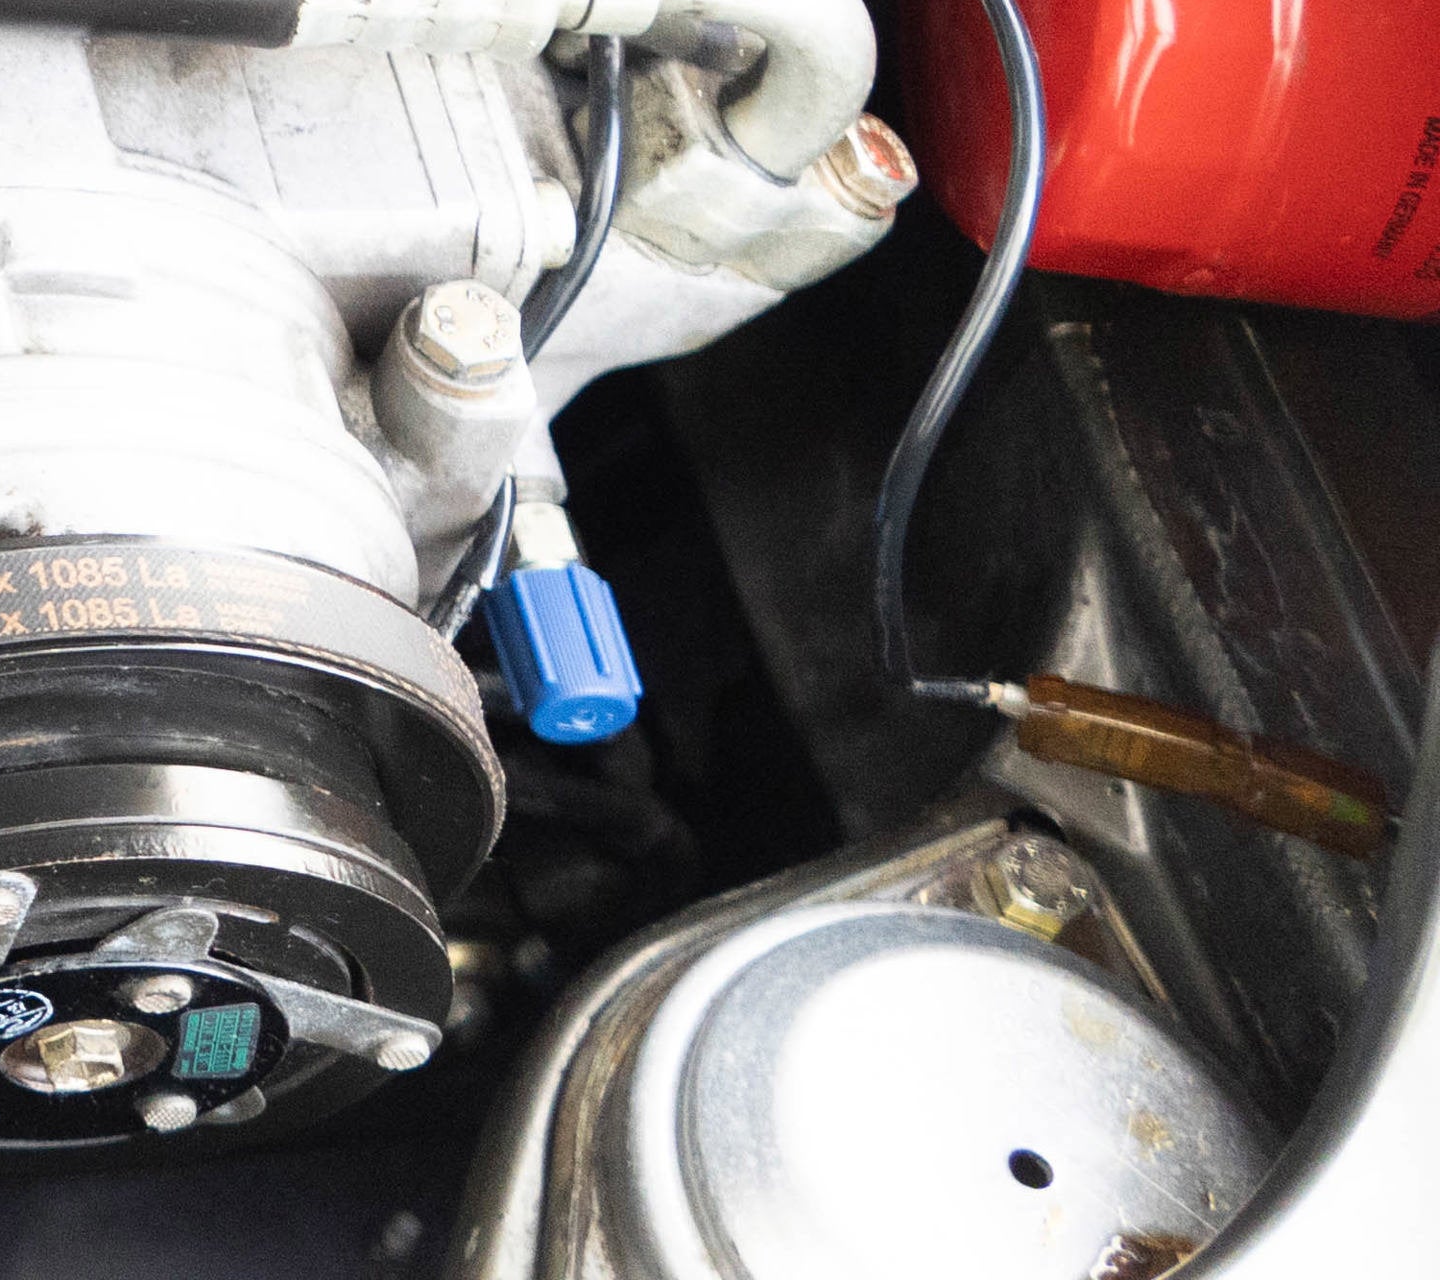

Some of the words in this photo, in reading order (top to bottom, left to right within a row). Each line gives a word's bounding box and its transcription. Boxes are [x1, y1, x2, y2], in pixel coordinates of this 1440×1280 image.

[28, 555, 129, 590] 1085
[137, 555, 191, 589] La
[38, 596, 140, 632] 1085
[147, 595, 203, 629] La
